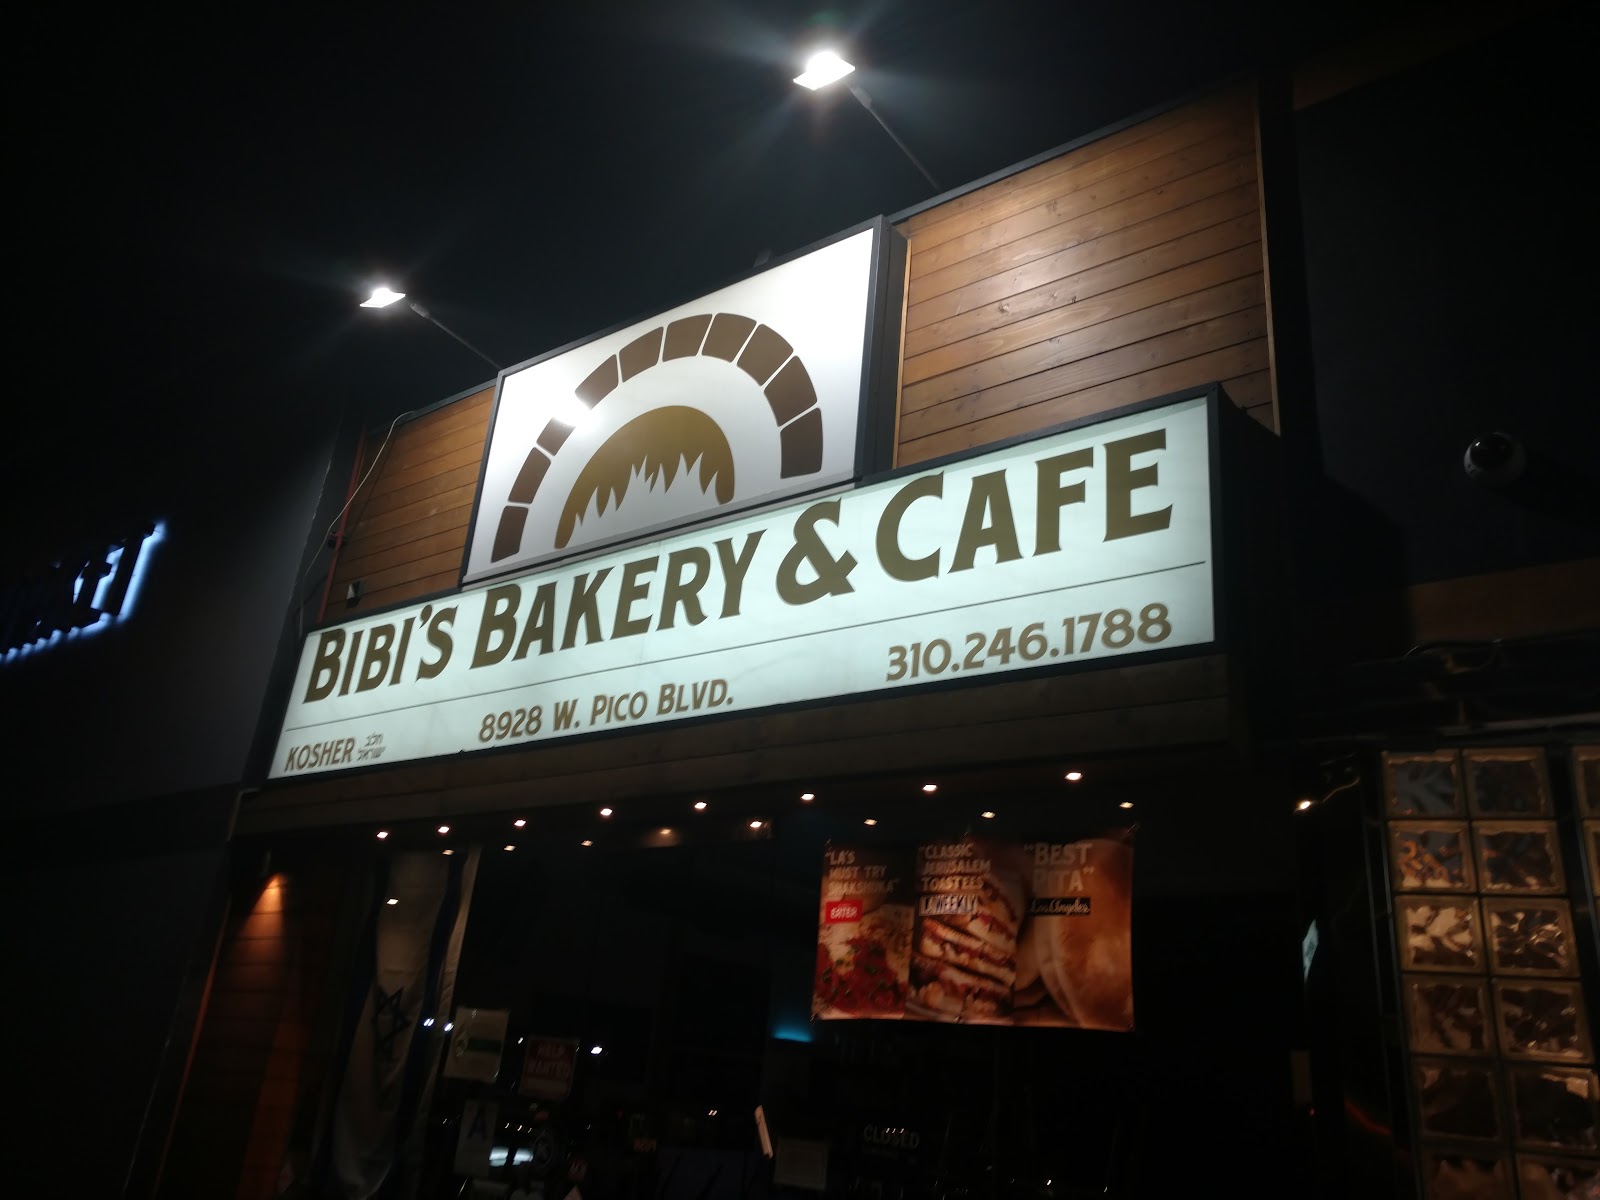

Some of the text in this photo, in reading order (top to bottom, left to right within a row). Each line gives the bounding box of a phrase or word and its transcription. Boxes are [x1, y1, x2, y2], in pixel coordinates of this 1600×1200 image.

[302, 428, 1173, 704] BIBI'S BAKERY & CAFE
[885, 602, 1172, 682] 310.246.1788
[478, 678, 734, 743] 8928 W. PICO BLVD.
[284, 737, 356, 772] KOSHER
